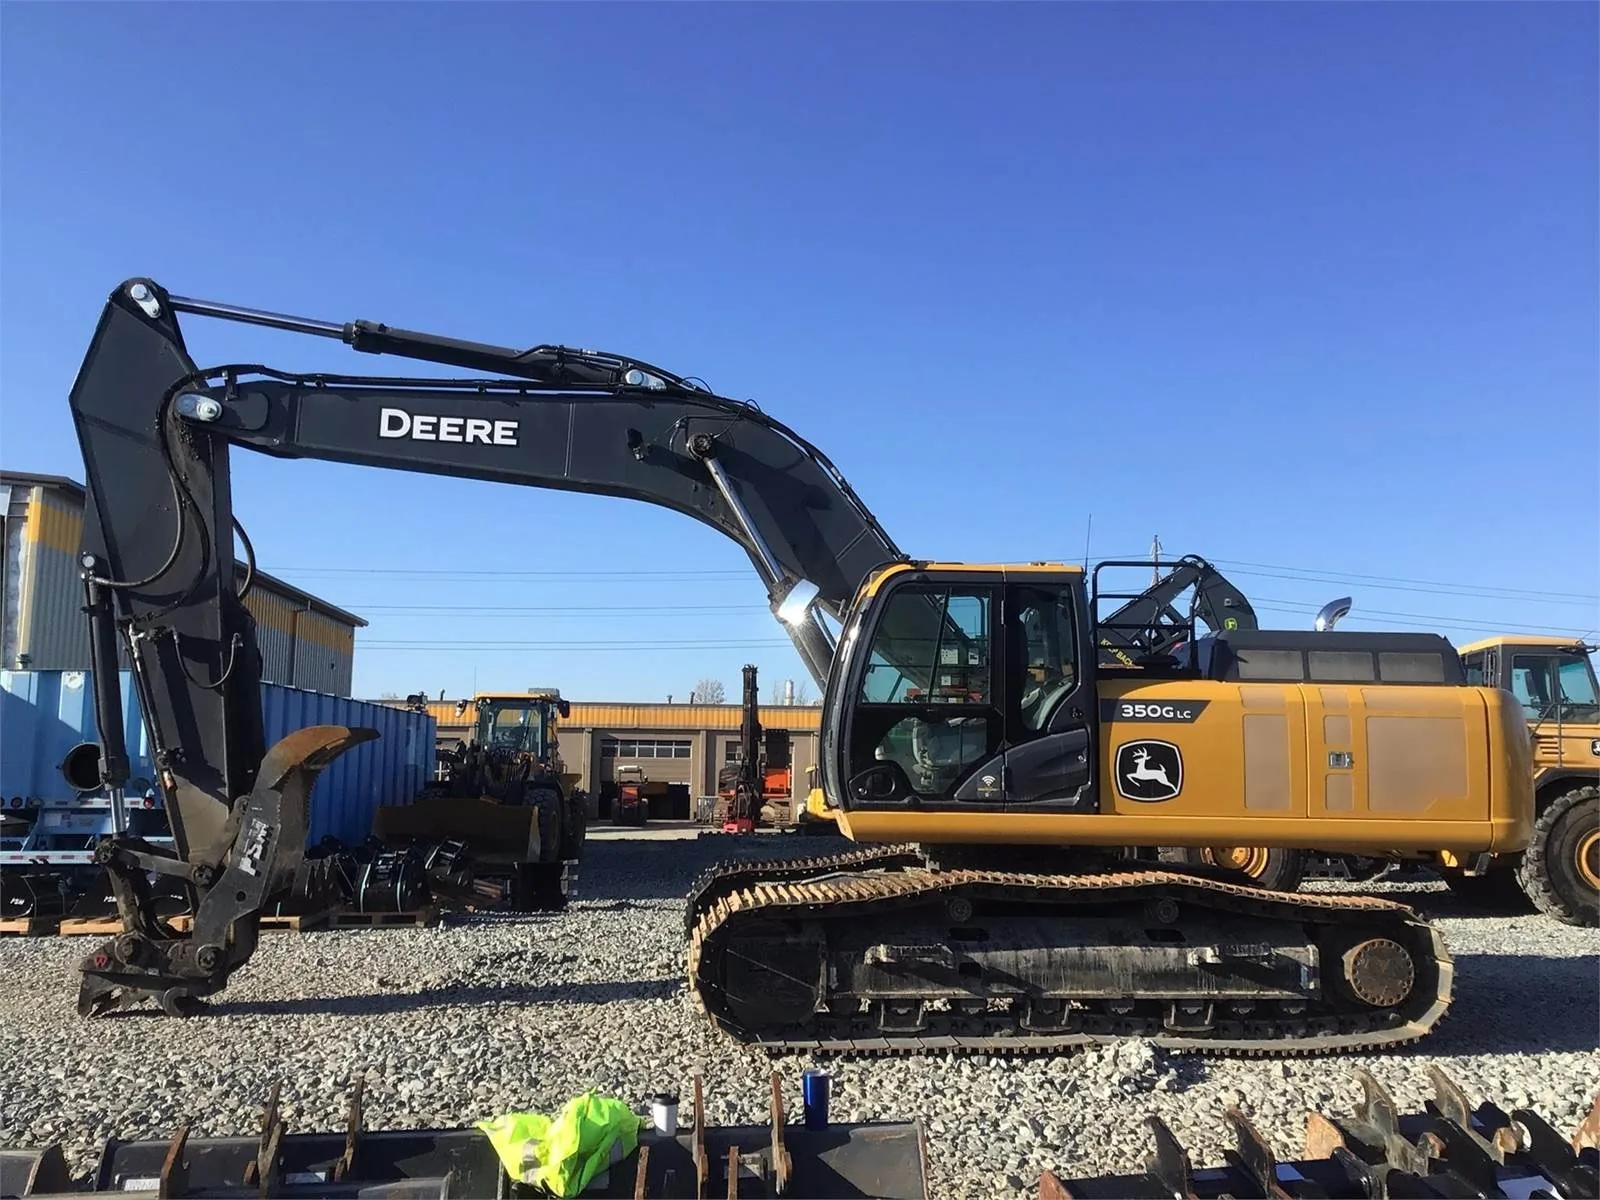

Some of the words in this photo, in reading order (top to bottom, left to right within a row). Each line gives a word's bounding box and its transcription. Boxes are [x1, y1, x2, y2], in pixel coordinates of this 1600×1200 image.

[379, 407, 519, 446] DEERE
[1100, 638, 1119, 654] KEP
[1121, 704, 1174, 719] 350G
[1176, 710, 1192, 719] LC
